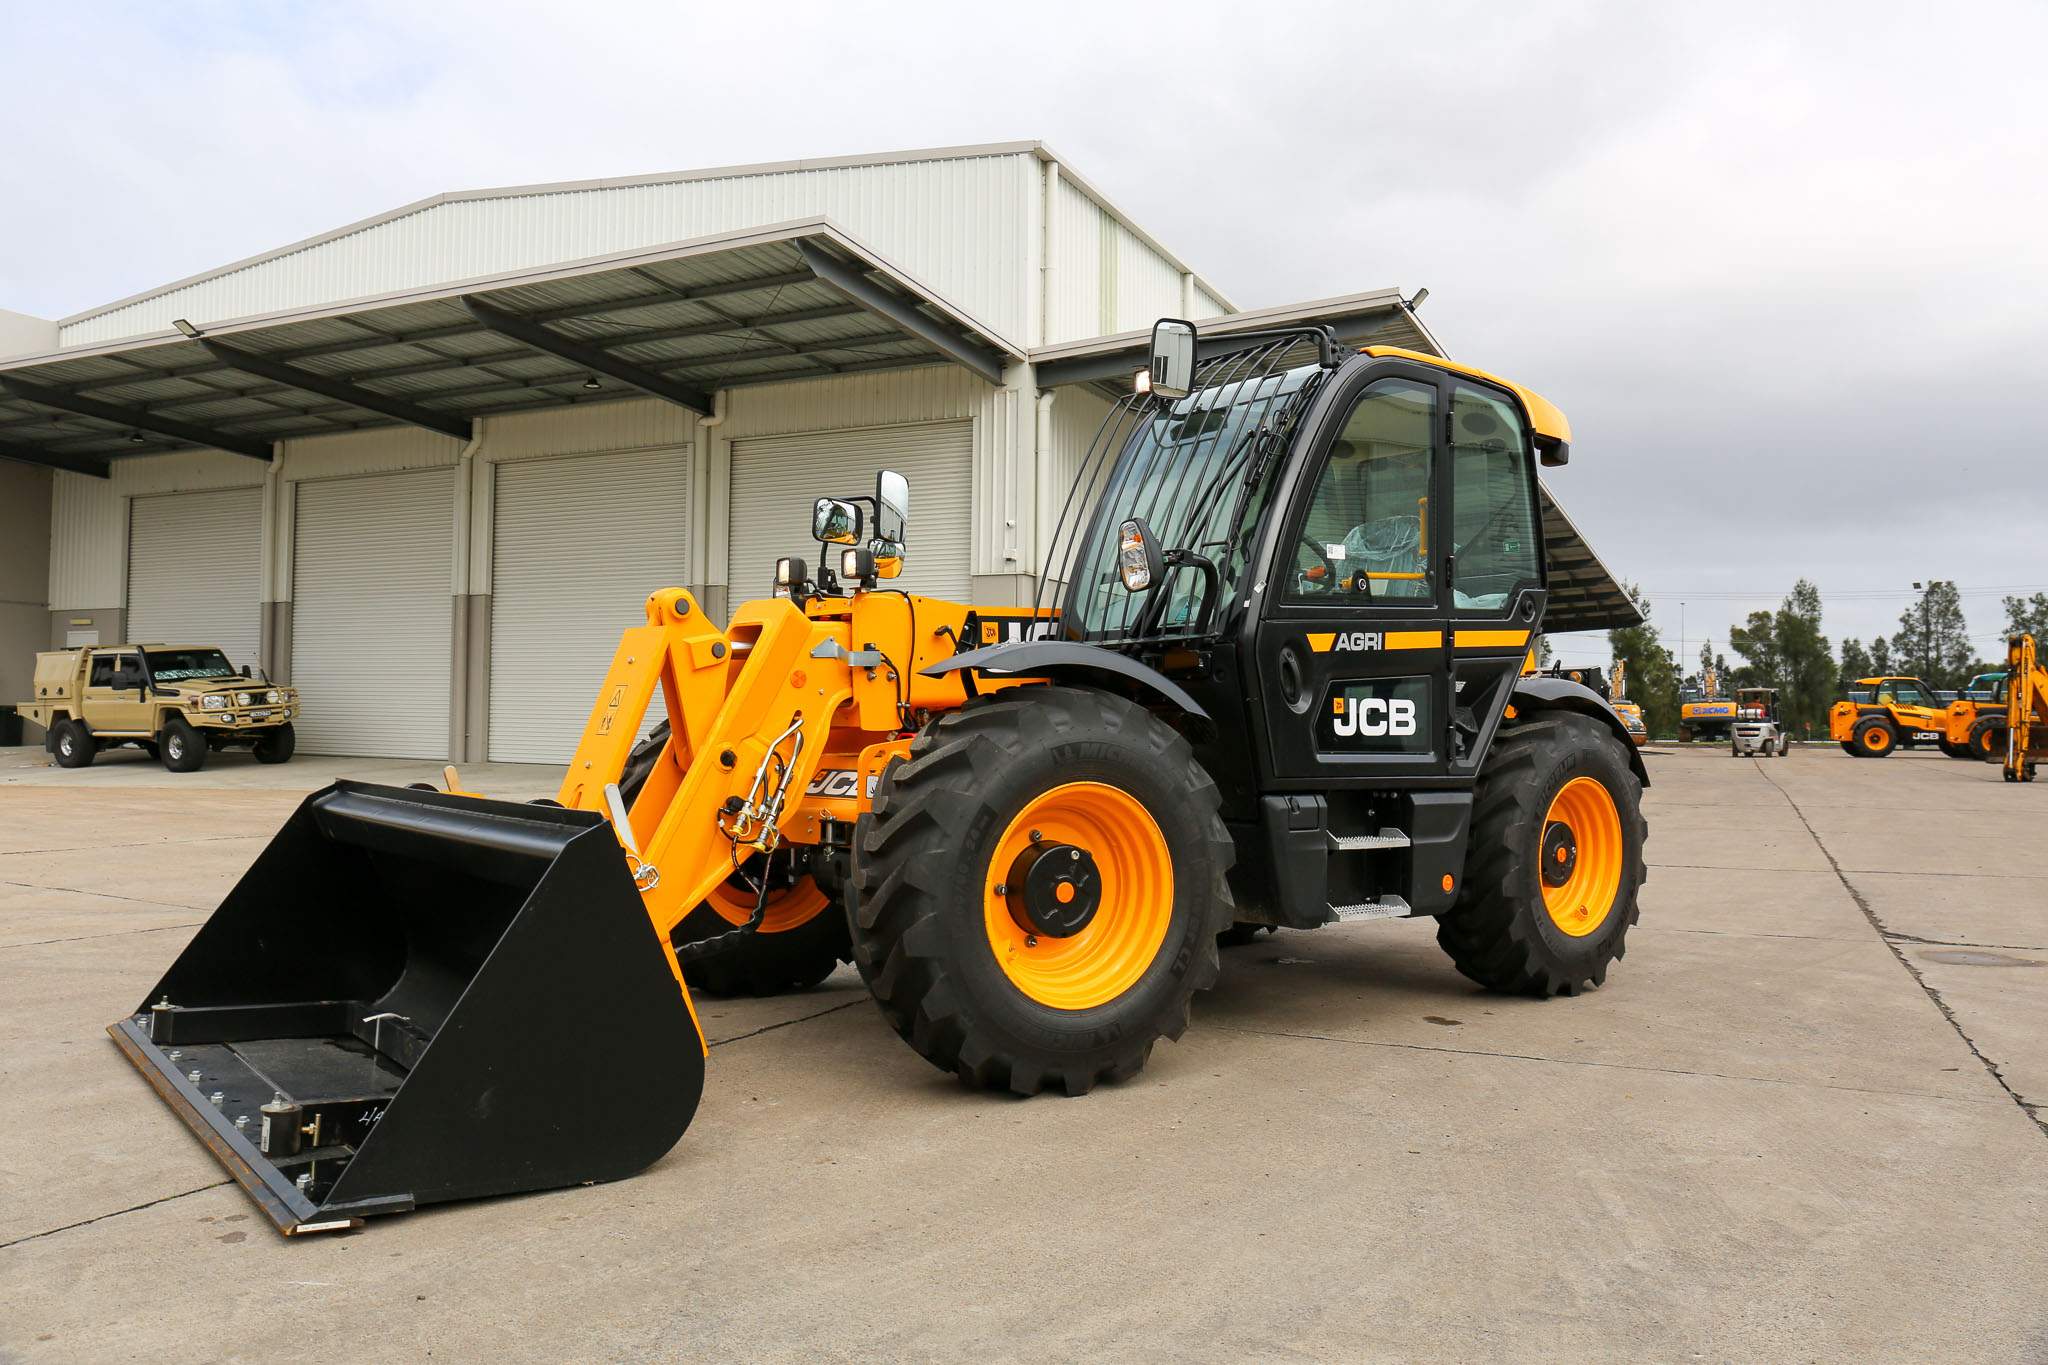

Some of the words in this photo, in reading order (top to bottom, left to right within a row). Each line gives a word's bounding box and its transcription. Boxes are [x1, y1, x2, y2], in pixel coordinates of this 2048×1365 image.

[1335, 633, 1383, 652] AGRI
[1334, 698, 1417, 737] JCB
[1912, 732, 1940, 740] JCB
